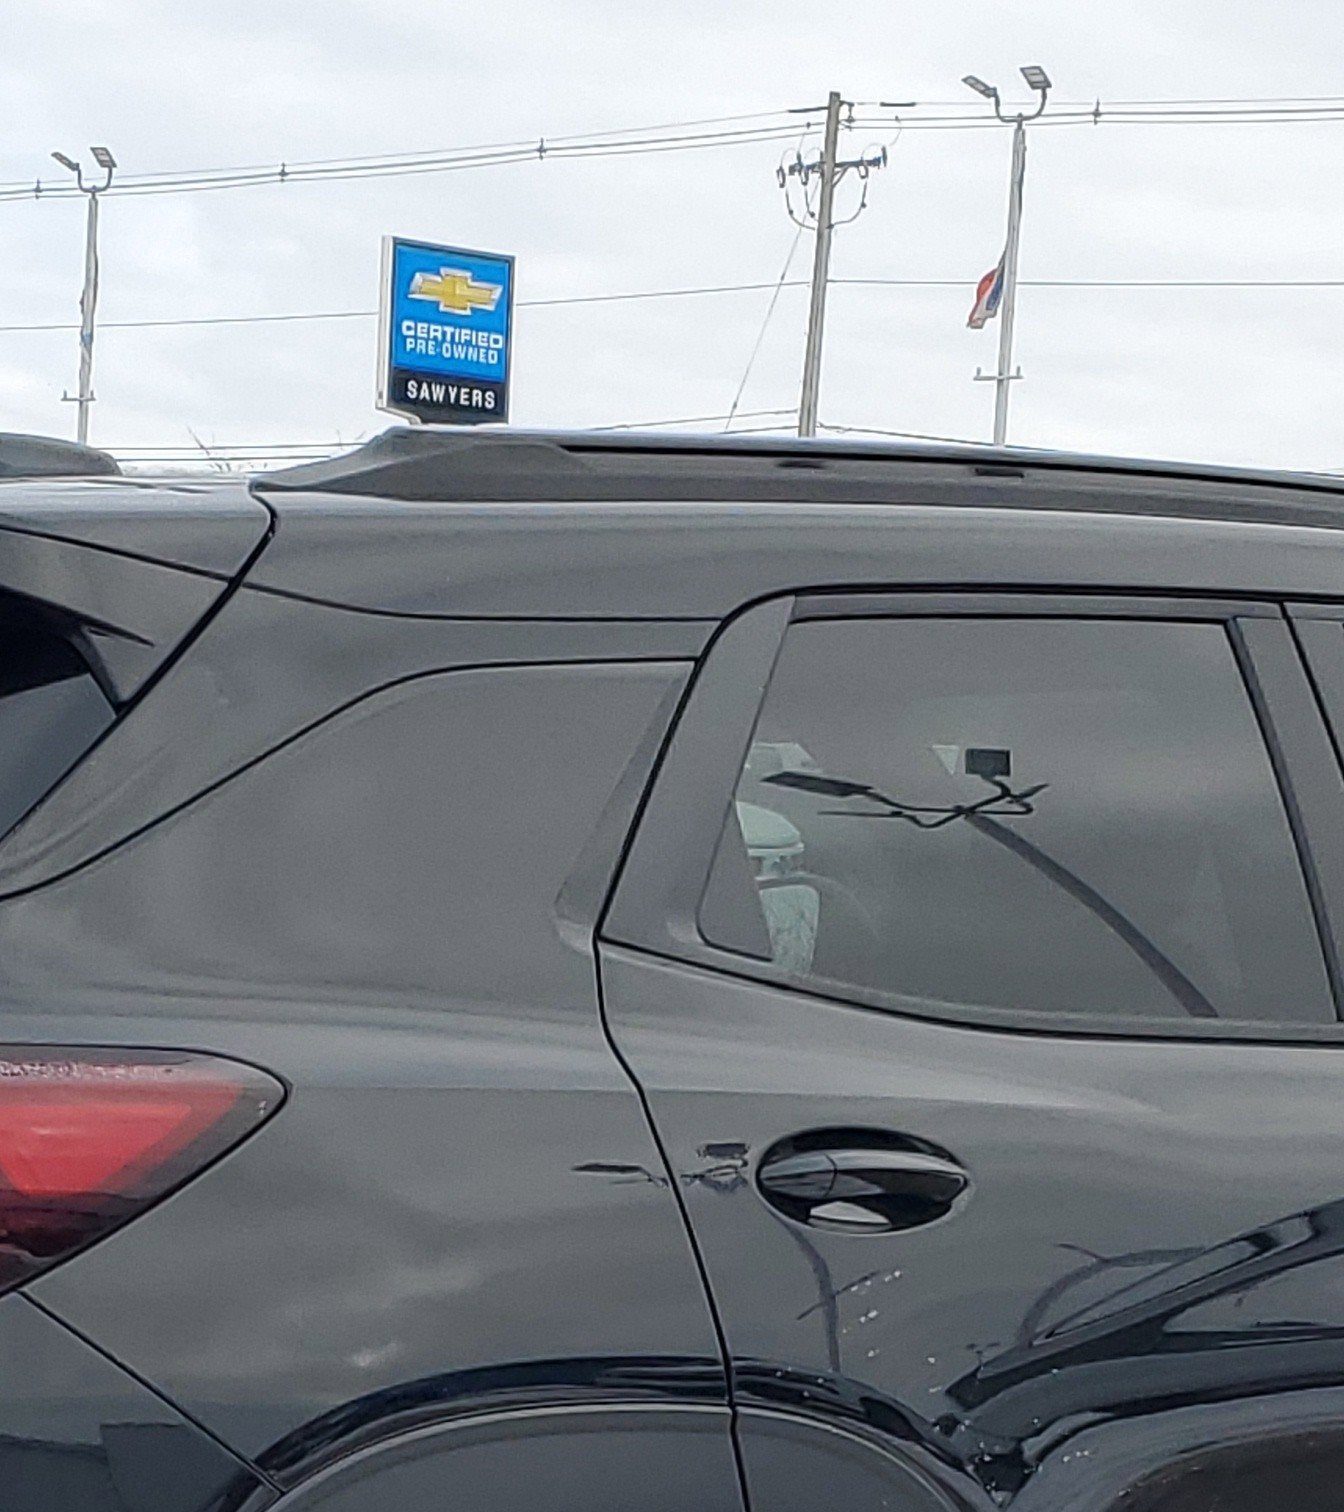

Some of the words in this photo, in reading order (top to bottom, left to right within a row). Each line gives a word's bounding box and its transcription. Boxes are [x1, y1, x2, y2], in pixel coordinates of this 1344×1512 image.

[401, 320, 503, 349] CERTIFIED
[406, 339, 498, 364] PRE-OWNED
[406, 380, 496, 409] SAWYERS
